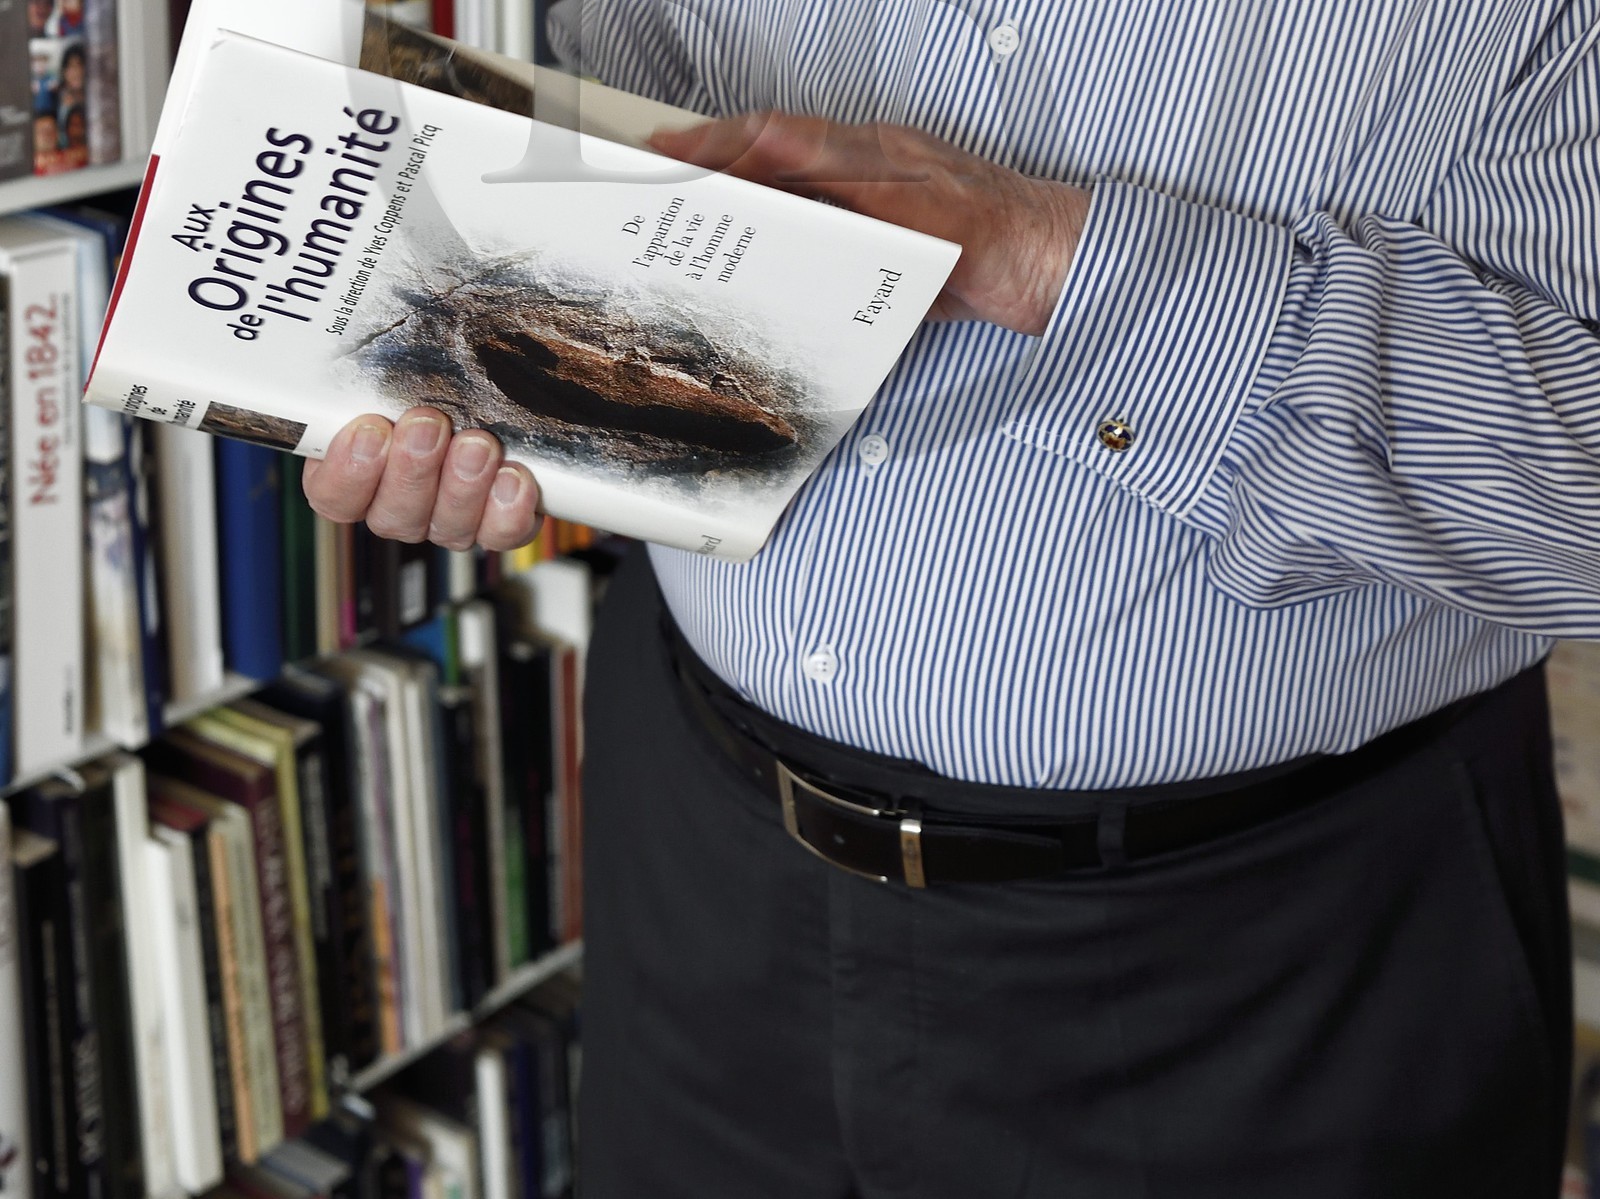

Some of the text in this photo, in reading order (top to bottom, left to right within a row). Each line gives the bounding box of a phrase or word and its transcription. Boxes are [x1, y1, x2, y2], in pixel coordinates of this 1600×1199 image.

[171, 203, 216, 252] Aux
[187, 127, 313, 311] Origines
[227, 107, 400, 341] de l'humanité
[325, 123, 443, 336] Sous la direction de Yves Coppens et Pascal Picq
[621, 213, 646, 237] De
[632, 196, 685, 269] l'apparition
[664, 212, 706, 267] de la vie
[684, 212, 735, 282] à l'homme
[717, 224, 757, 284] moderne
[852, 267, 903, 327] Fayard
[24, 294, 59, 506] Née en 1842.
